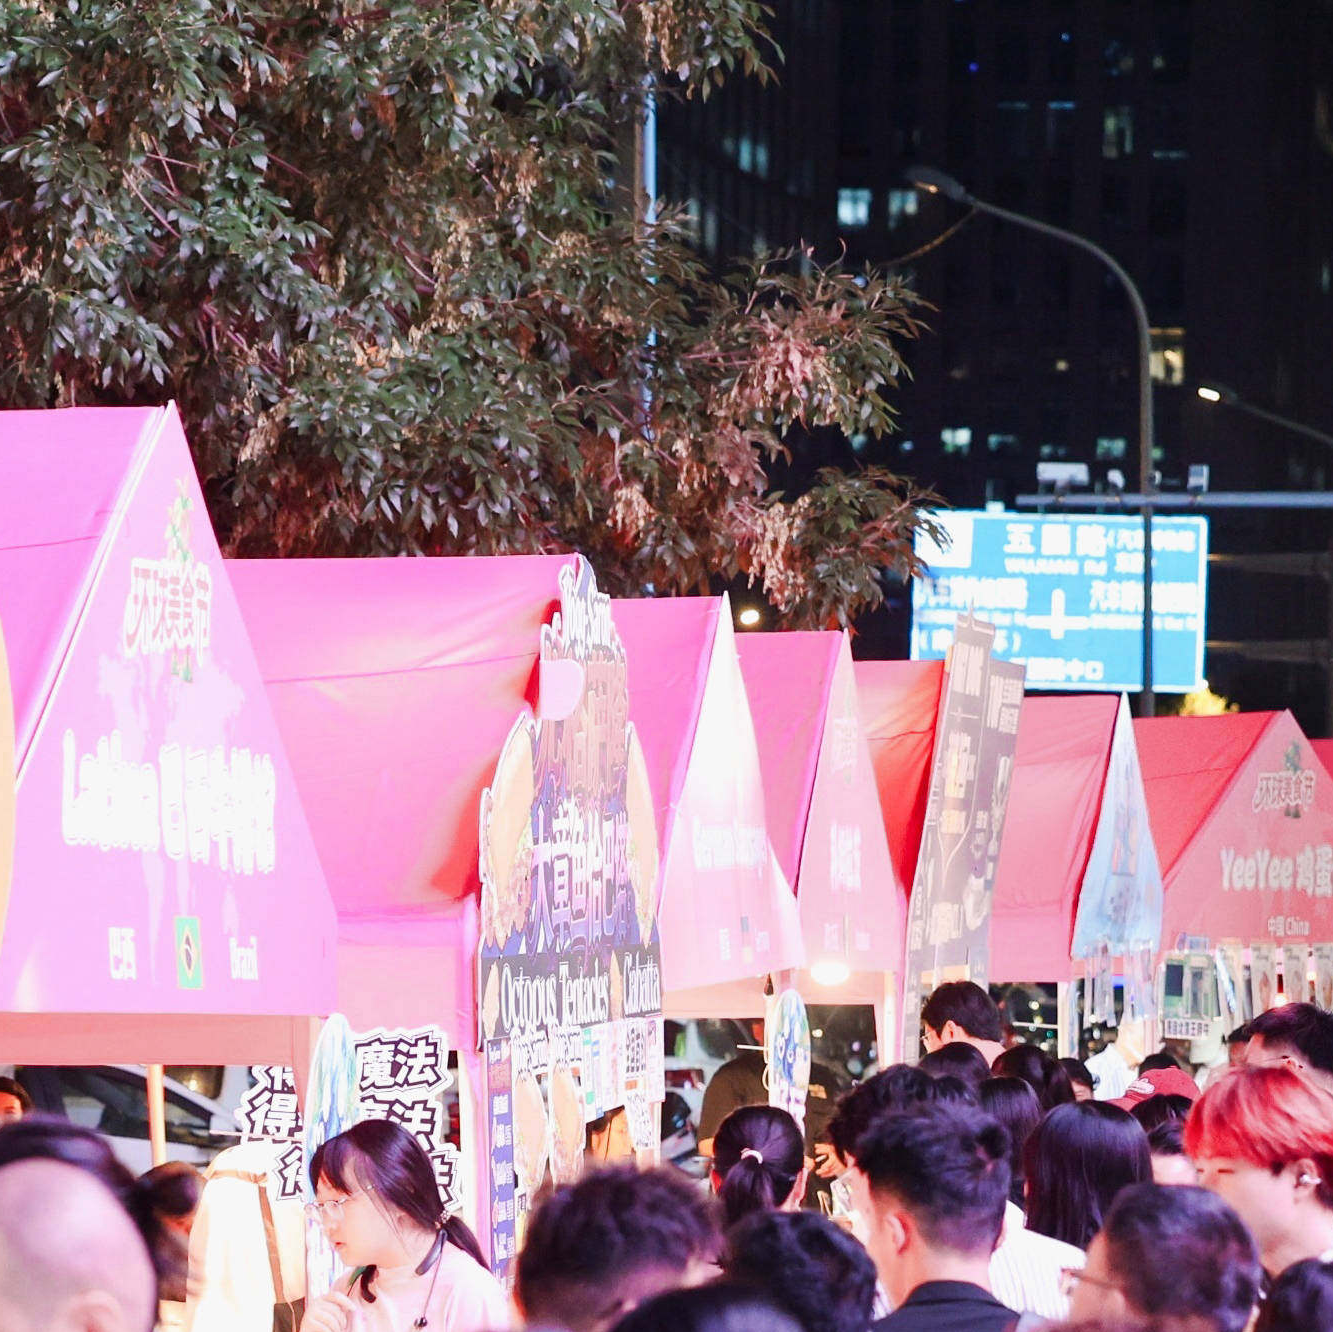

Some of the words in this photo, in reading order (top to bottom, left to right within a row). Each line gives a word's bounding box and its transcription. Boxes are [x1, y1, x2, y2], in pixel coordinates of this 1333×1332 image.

[1220, 846, 1294, 891] YeeYee
[1286, 916, 1310, 937] China
[501, 962, 557, 1029] Octopus
[357, 1038, 439, 1088] 魔法
